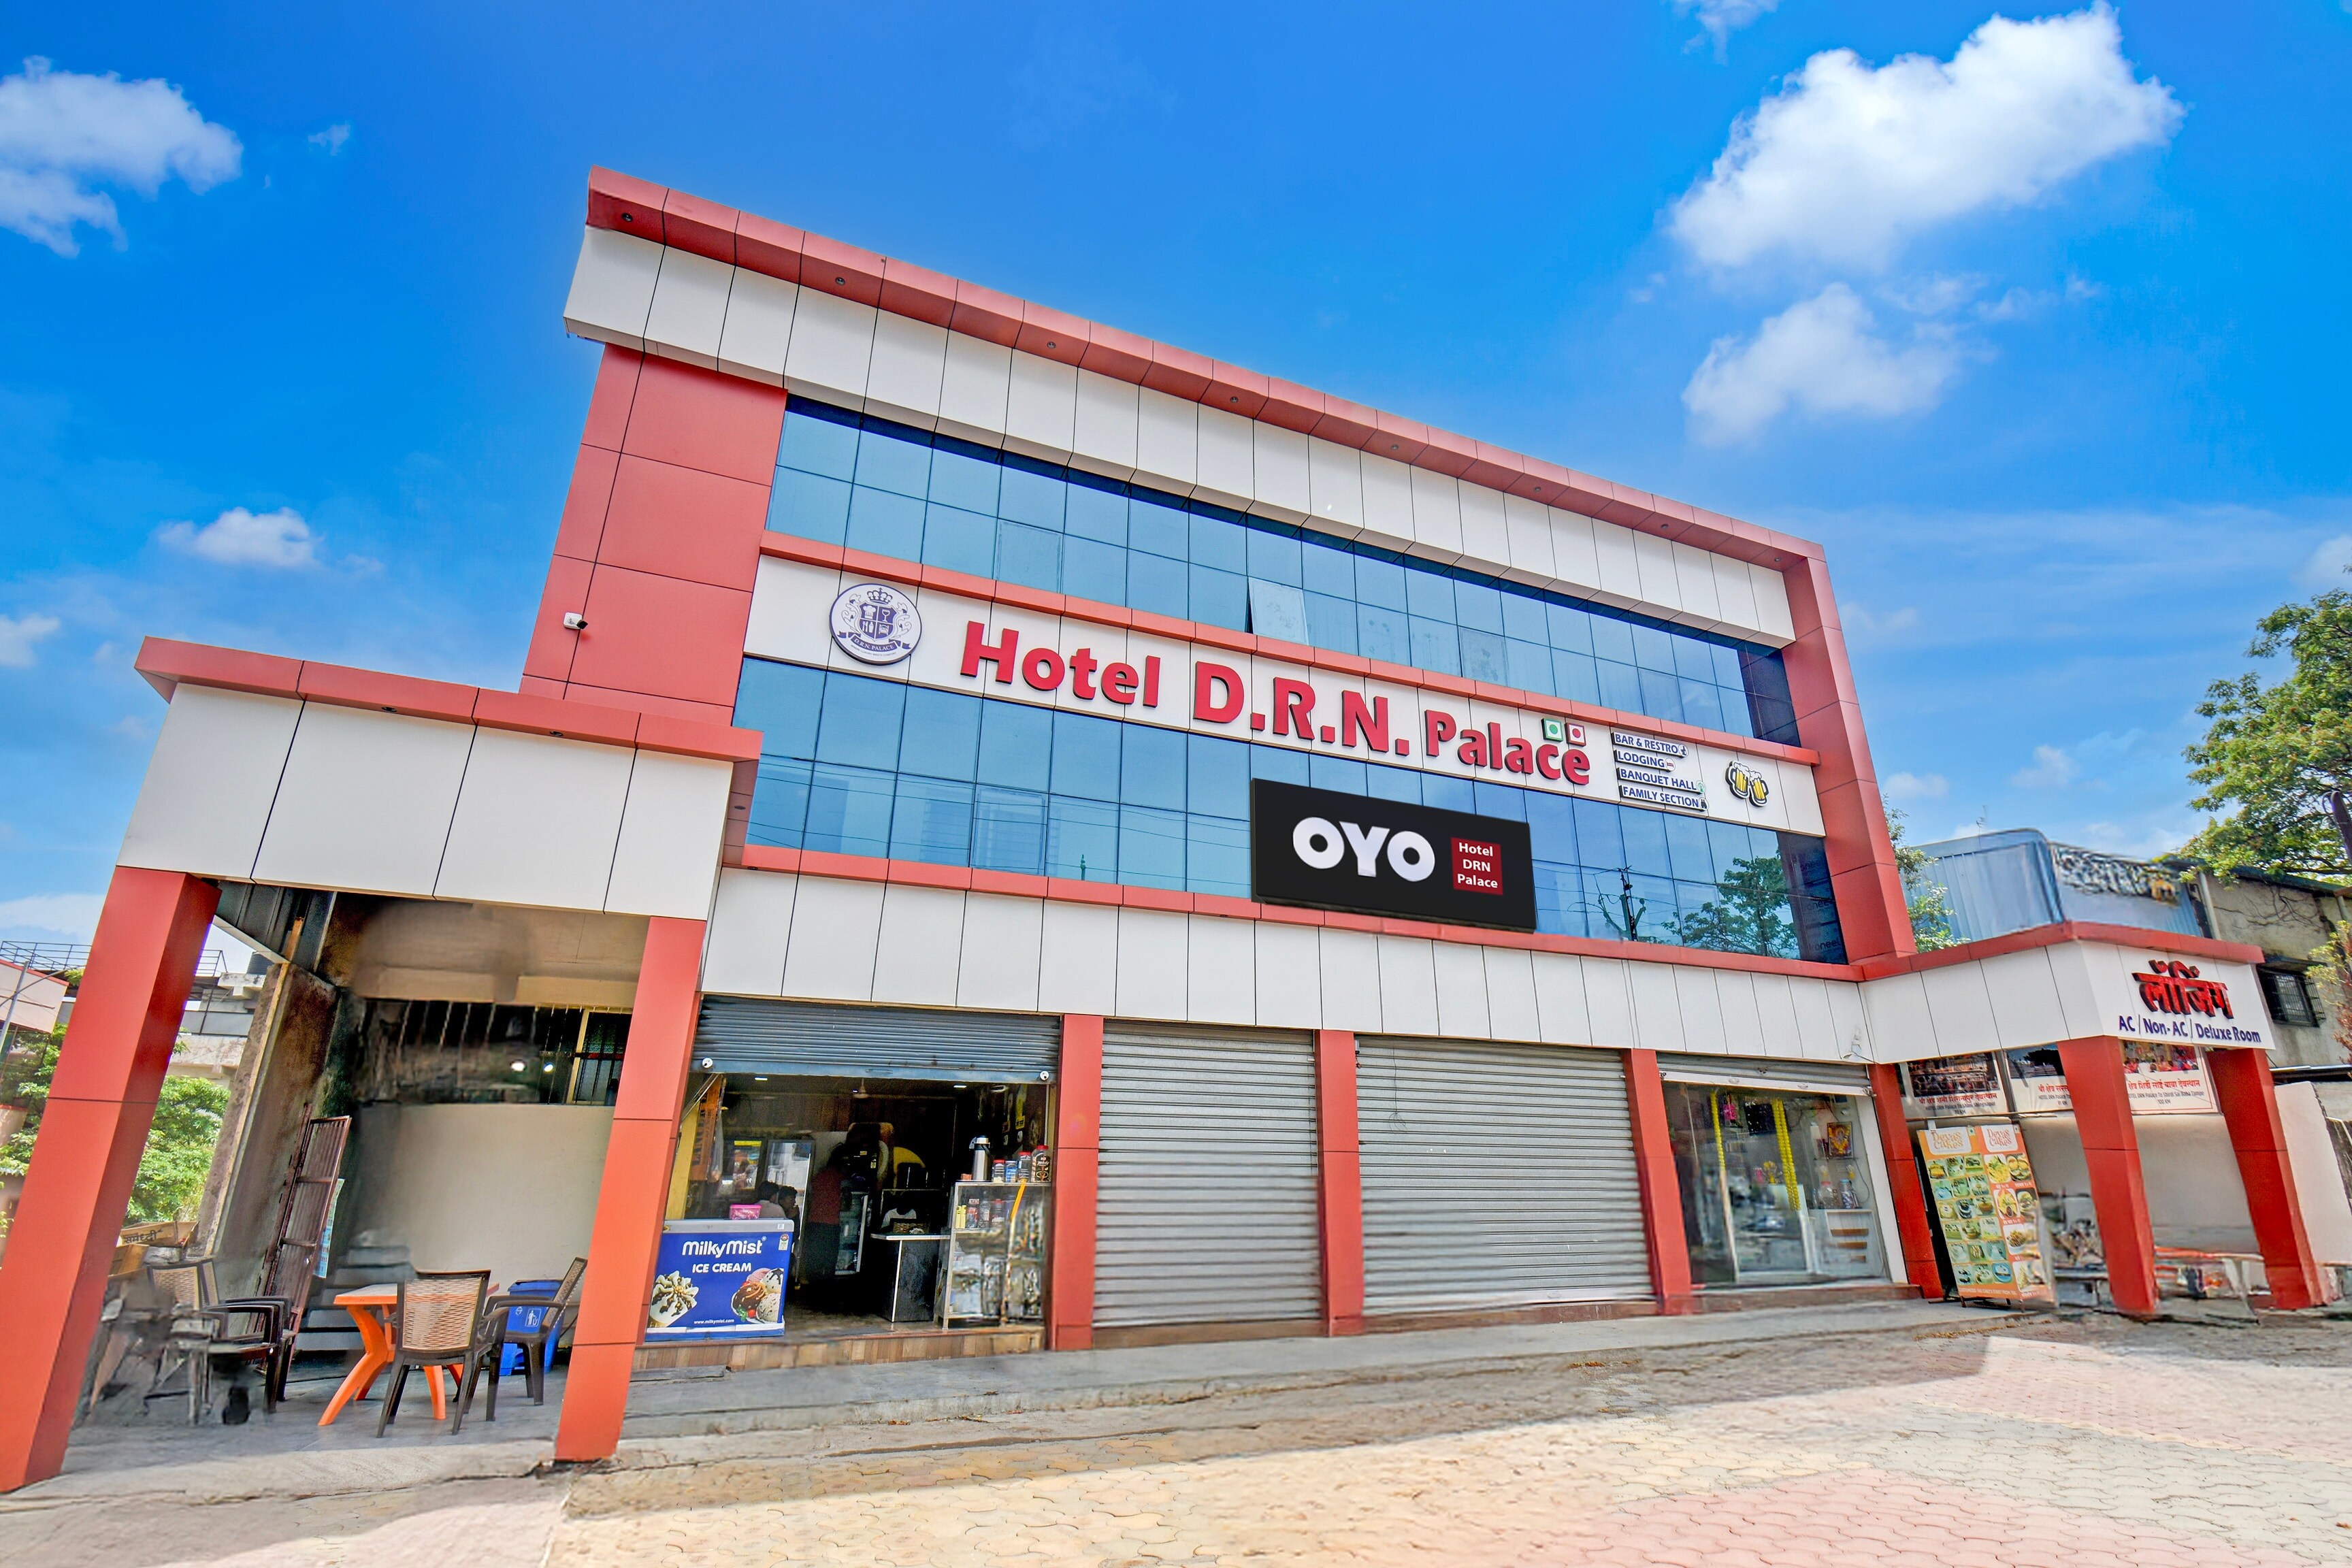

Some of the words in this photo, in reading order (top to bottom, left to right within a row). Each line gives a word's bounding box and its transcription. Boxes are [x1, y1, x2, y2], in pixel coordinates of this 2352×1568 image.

[960, 621, 1160, 708] Hotel
[1193, 661, 1409, 756] D.R.N.
[1424, 709, 1590, 785] Palace
[1615, 734, 1633, 745] BAR
[1636, 738, 1642, 747] &
[1645, 739, 1678, 754] RESTRO
[1618, 751, 1665, 768] LODGING
[1620, 768, 1669, 785] BANQUET
[1671, 778, 1697, 791] HALL
[1622, 786, 1657, 800] FAMILY
[1660, 793, 1699, 808] SECTION
[1292, 817, 1435, 882] OYO
[1458, 842, 1493, 857] Hotel
[1463, 858, 1490, 872] DRN
[1457, 873, 1498, 889] Palace
[2119, 1015, 2136, 1032] AC
[2195, 1023, 2232, 1040] Deluxe
[2232, 1026, 2261, 1043] Room
[692, 1264, 709, 1273] ICE
[712, 1262, 751, 1273] CREAM
